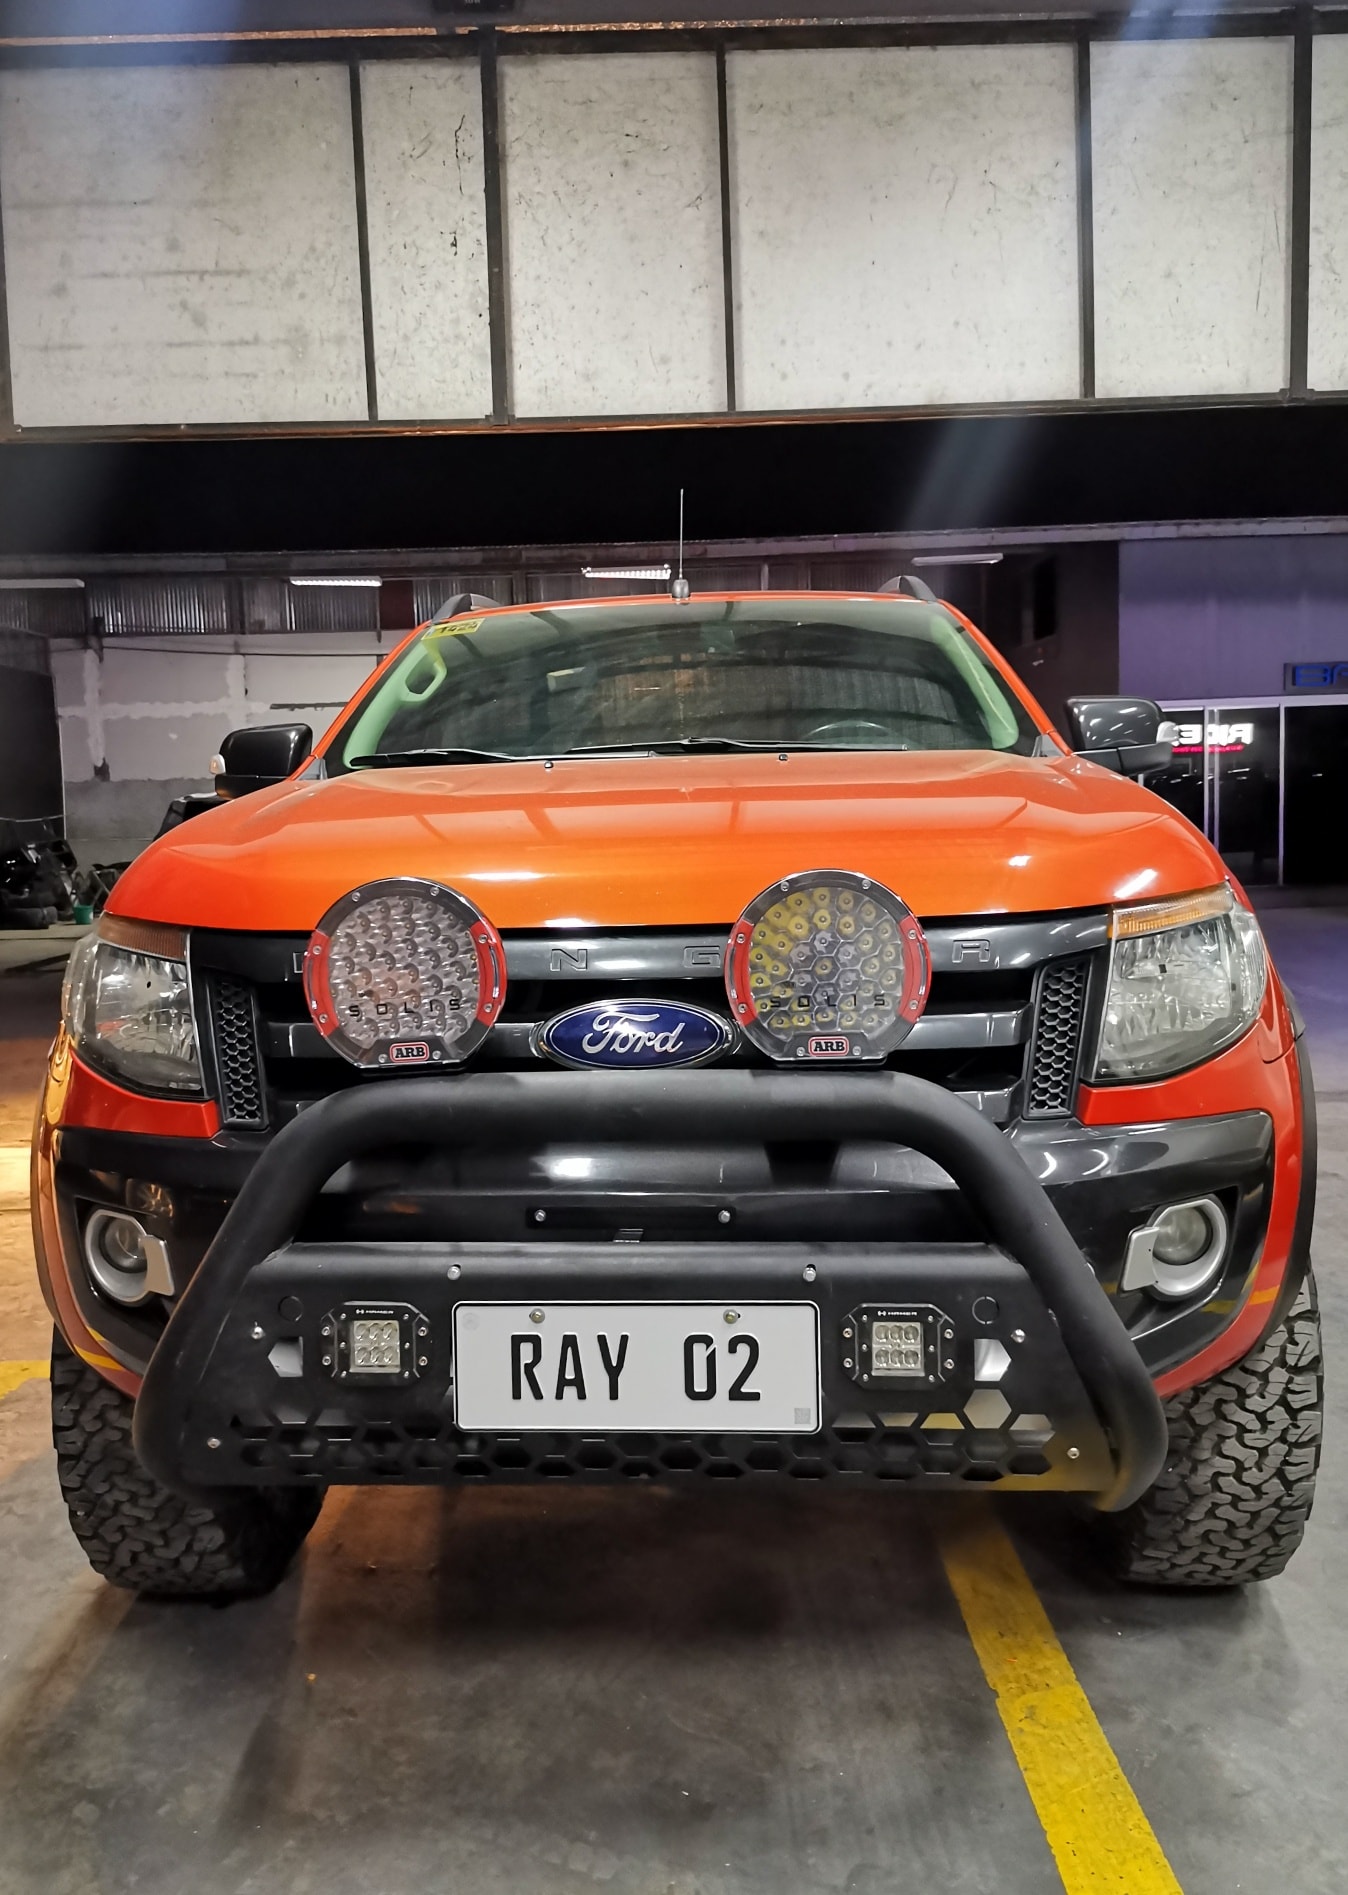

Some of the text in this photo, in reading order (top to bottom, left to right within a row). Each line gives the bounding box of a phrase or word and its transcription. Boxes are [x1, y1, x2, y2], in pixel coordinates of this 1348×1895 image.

[293, 938, 990, 973] NGR
[348, 999, 460, 1017] SOLIS
[770, 994, 885, 1008] SOLIS
[582, 1011, 686, 1054] Ford
[395, 1046, 425, 1058] ARB
[814, 1041, 845, 1052] ARB
[511, 1334, 761, 1401] RAY 02
